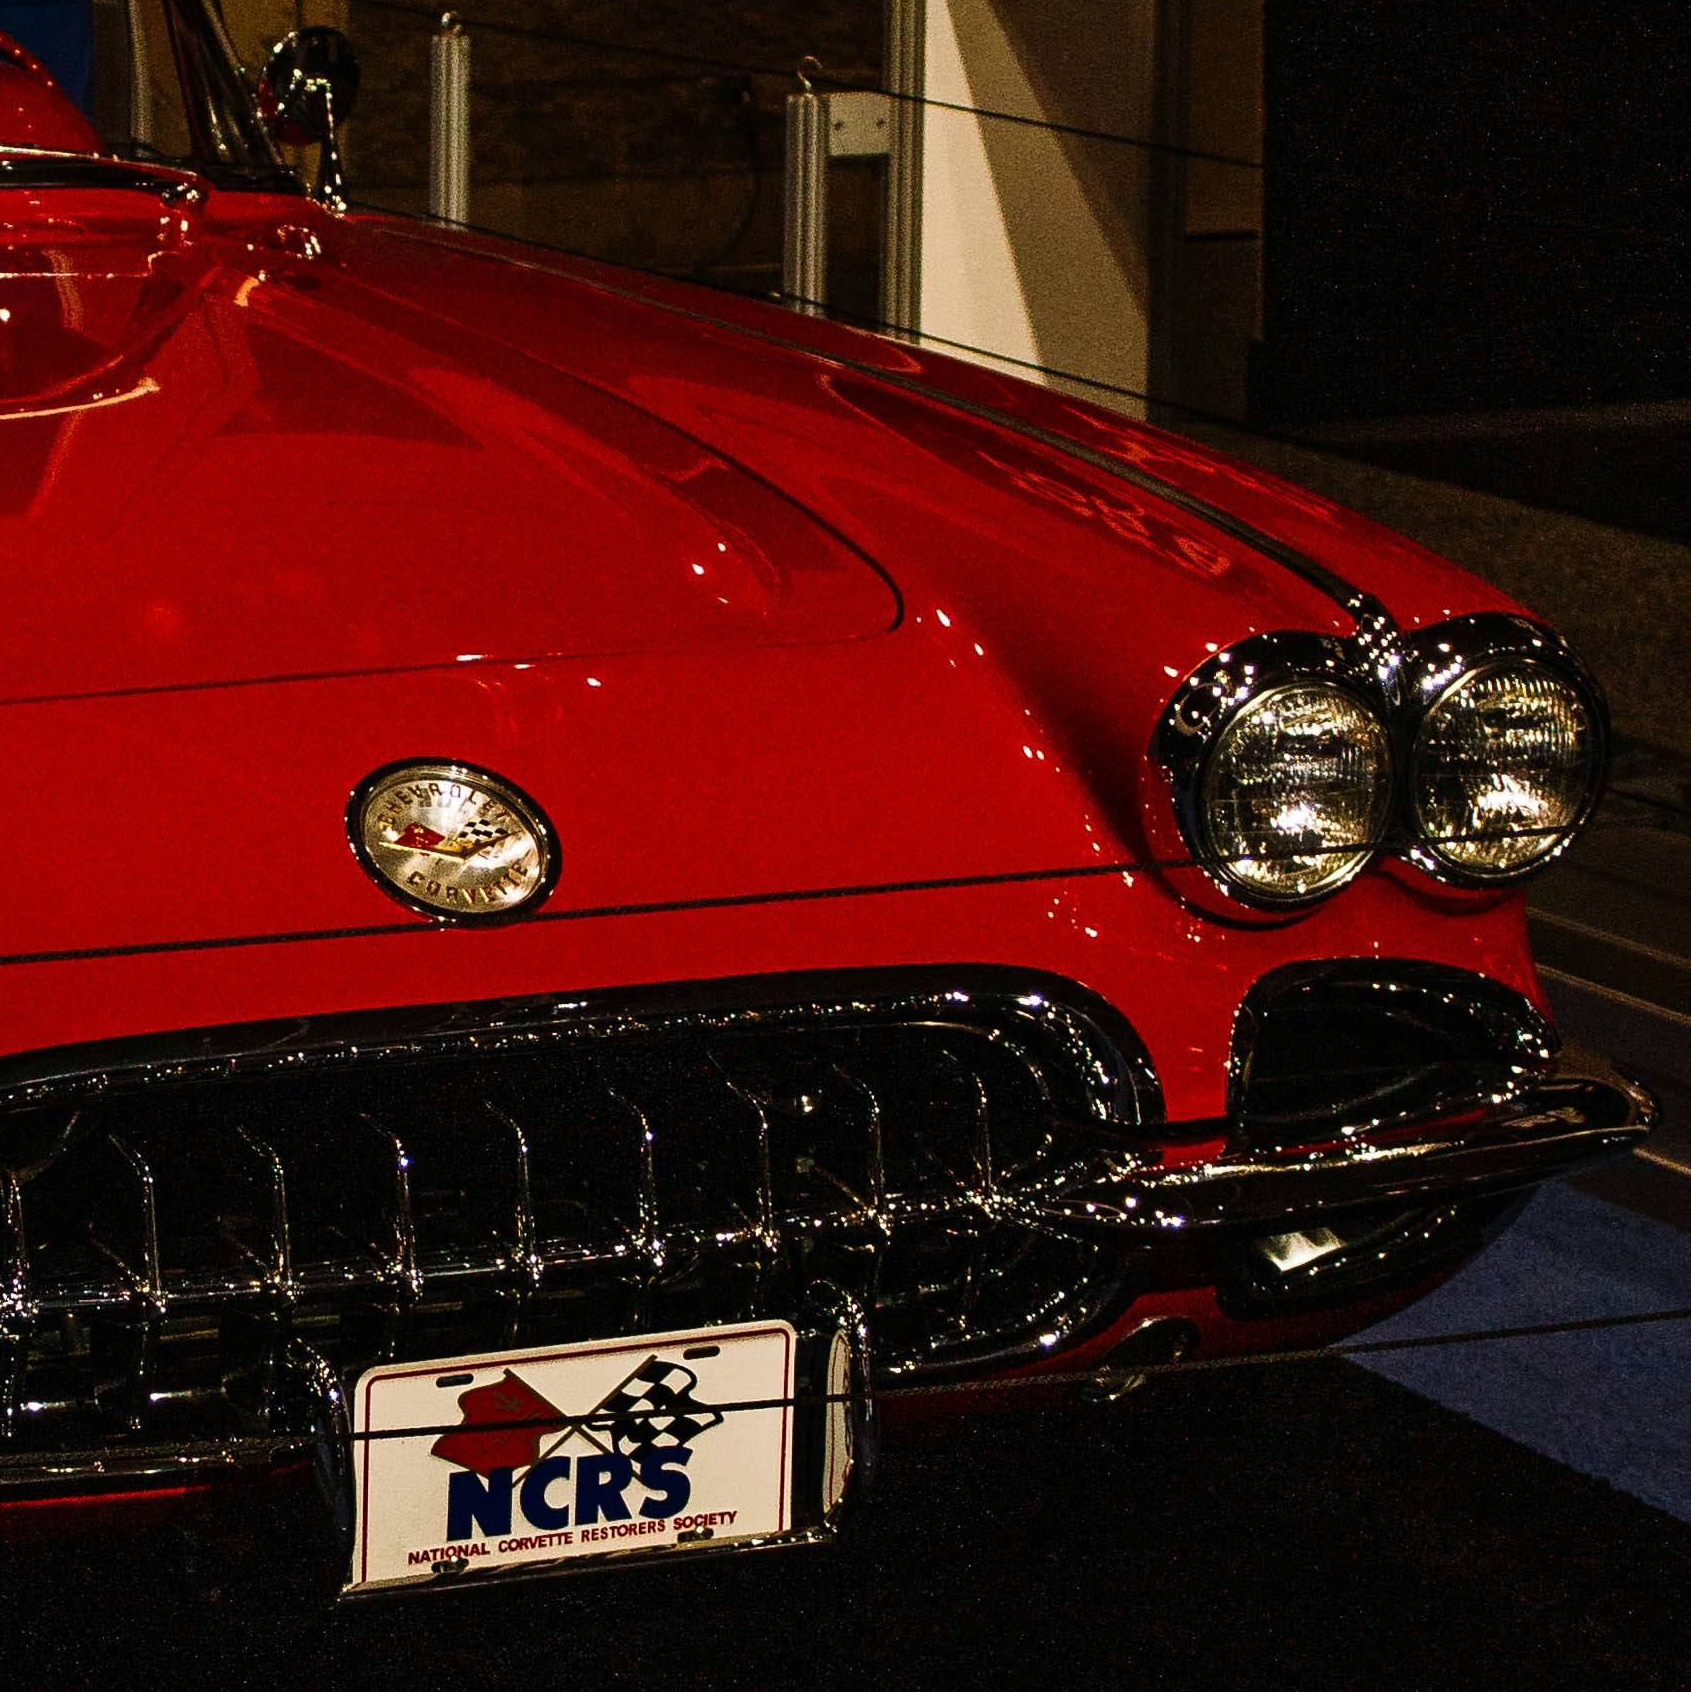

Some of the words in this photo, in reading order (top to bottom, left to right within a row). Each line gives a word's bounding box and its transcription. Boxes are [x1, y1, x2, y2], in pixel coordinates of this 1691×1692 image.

[446, 1445, 693, 1543] NCRS
[408, 1542, 490, 1566] NATIONAL
[498, 1531, 573, 1553] CORVETTE
[581, 1519, 666, 1543] RESTORERS
[673, 1509, 738, 1531] SOCIETY
